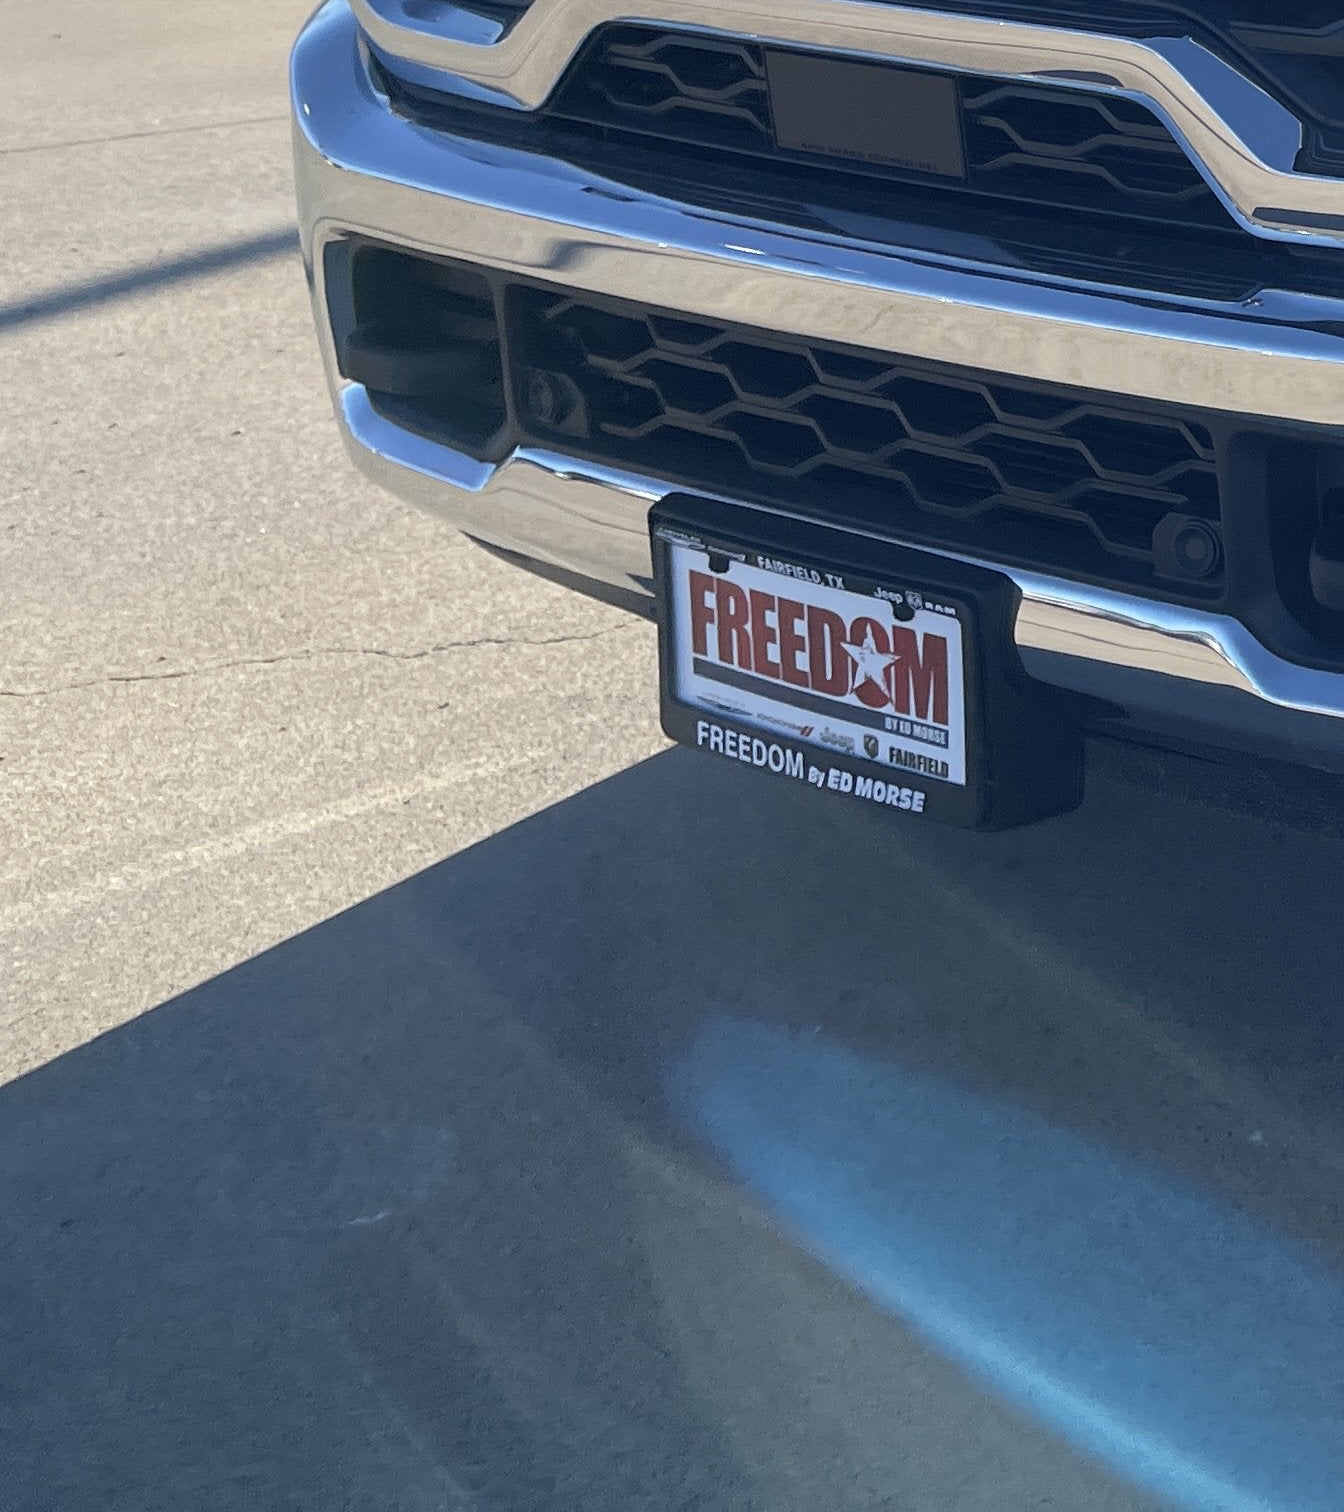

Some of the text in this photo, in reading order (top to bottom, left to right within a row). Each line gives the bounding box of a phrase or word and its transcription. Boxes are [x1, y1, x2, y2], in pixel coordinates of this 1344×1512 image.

[756, 555, 846, 590] FAIRFIELD, TX
[873, 586, 904, 605] Jeep
[688, 568, 949, 725] FREEDOM
[885, 717, 899, 731] BY
[696, 720, 805, 780] FREEDOM
[827, 768, 853, 793] ED
[855, 776, 926, 813] MORSE
[888, 745, 949, 778] FAIRFIELD
